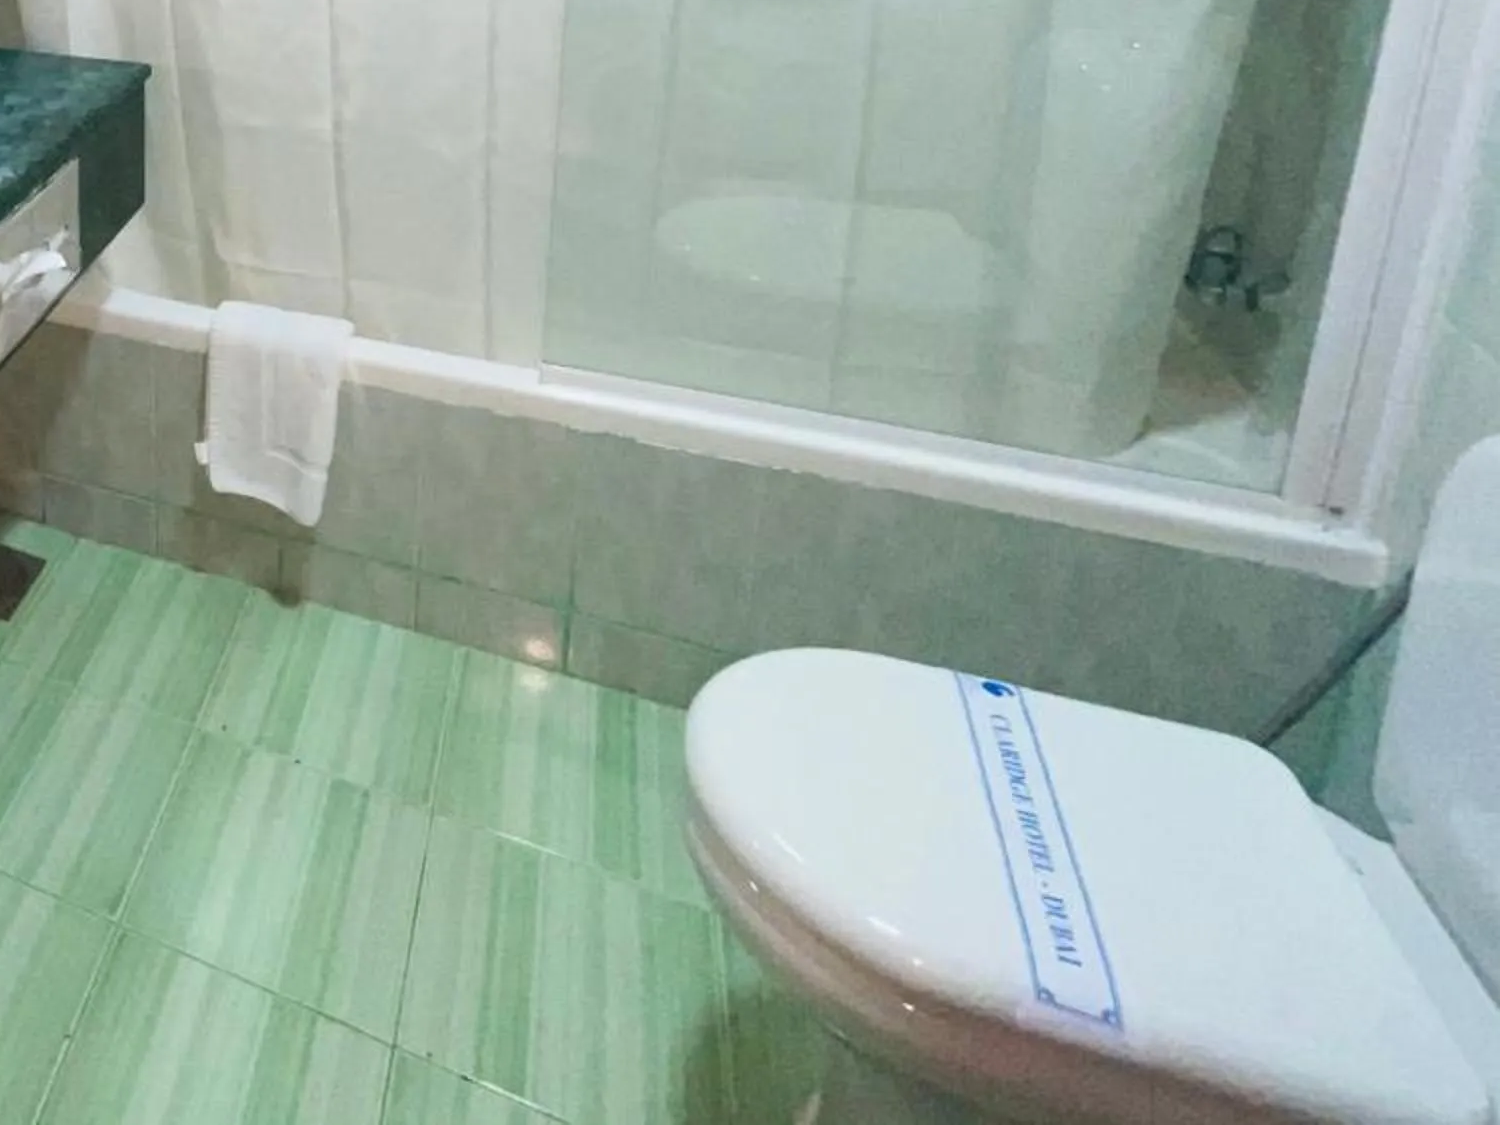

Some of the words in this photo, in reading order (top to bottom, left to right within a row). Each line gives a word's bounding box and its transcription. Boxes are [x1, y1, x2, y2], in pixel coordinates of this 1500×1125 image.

[990, 714, 1034, 805] CLARIDGE
[1016, 809, 1054, 873] HOTEL
[1041, 894, 1083, 968] DUBAI
